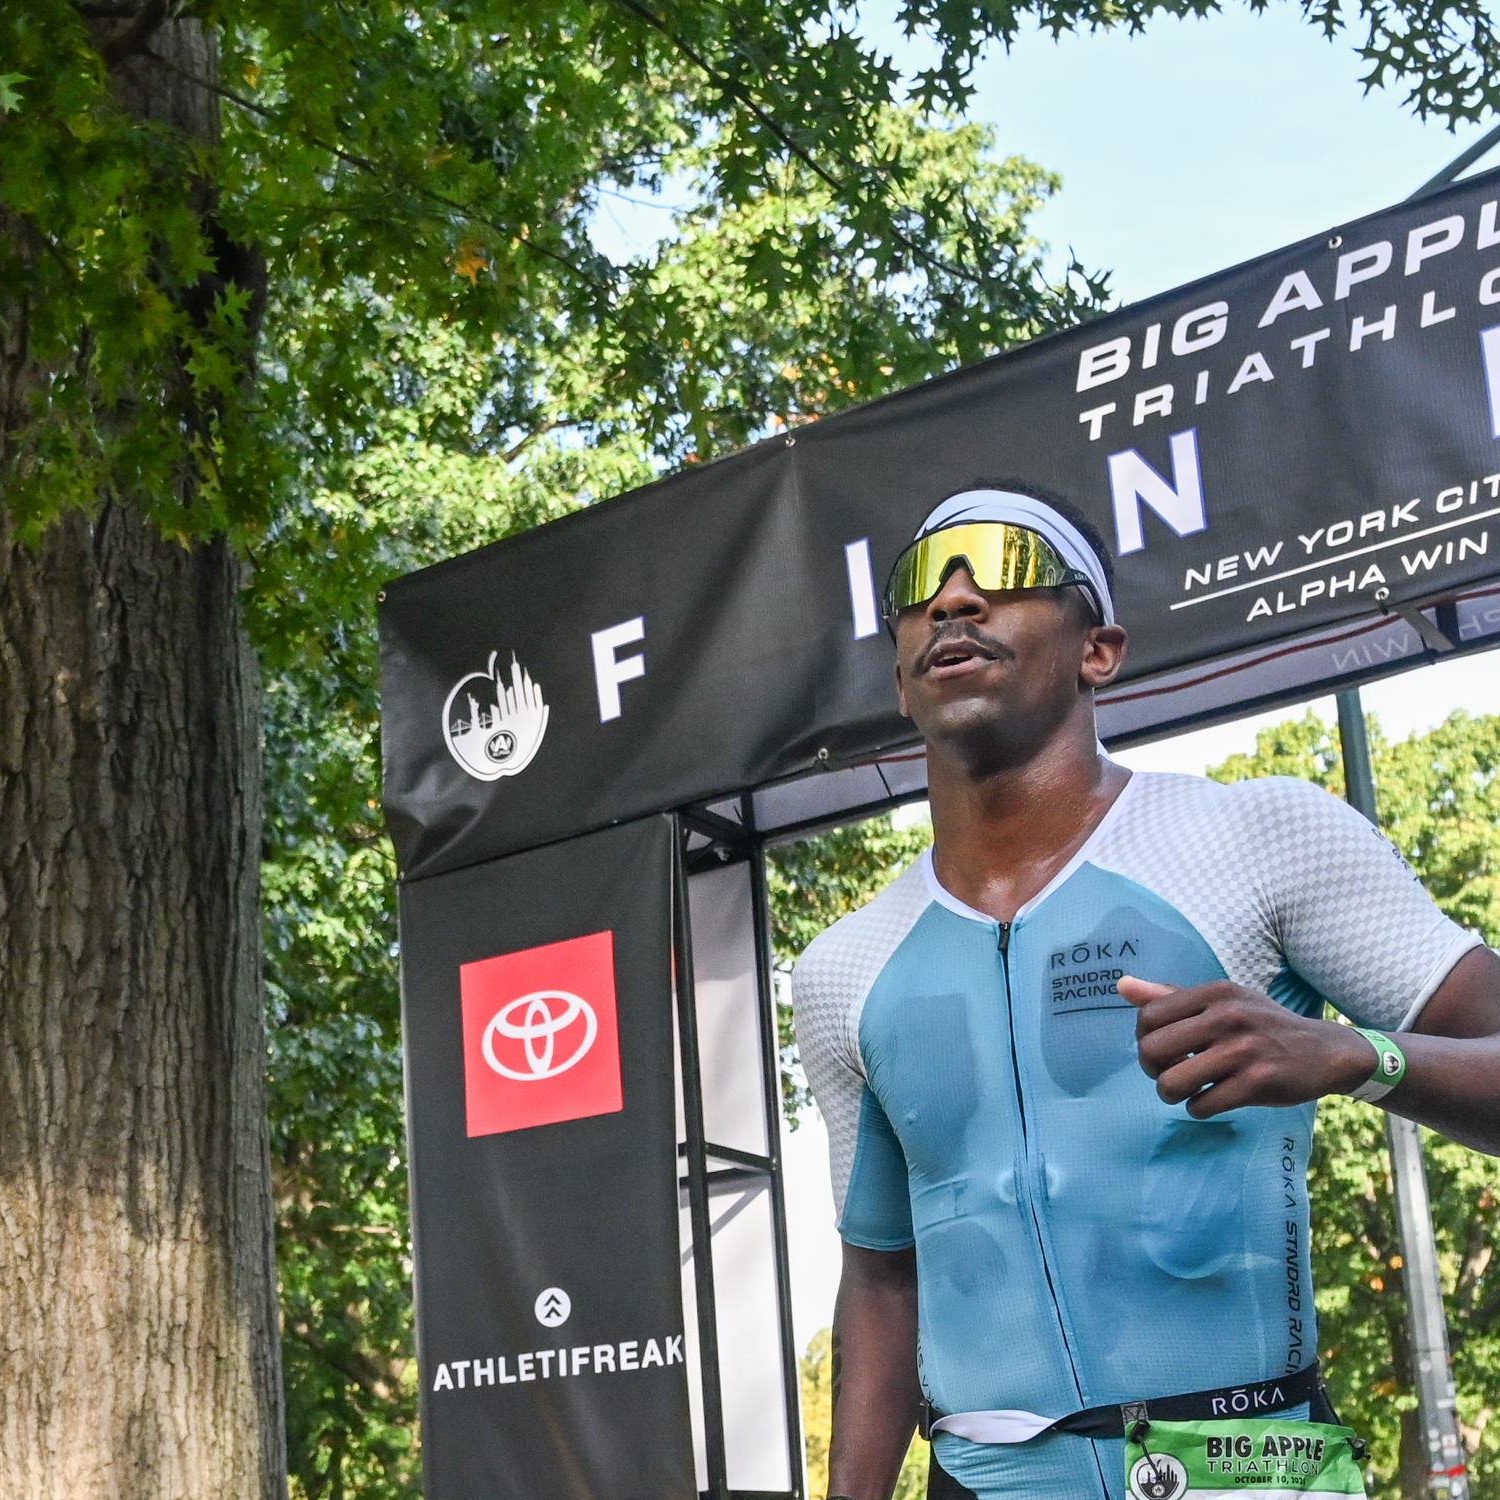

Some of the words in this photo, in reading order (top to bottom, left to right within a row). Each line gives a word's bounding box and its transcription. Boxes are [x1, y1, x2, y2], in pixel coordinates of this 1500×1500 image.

[1076, 300, 1229, 393] BIG
[1184, 541, 1284, 591] NEW
[1297, 498, 1422, 555] YORK
[1246, 563, 1387, 622] ALPHA
[1401, 532, 1489, 576] WIN
[1052, 968, 1123, 989] STNDRD
[1053, 983, 1119, 1002] RACING
[1286, 1220, 1301, 1312] STNDRD
[433, 1333, 686, 1392] ATHLETIFREAK
[1206, 1435, 1253, 1459] BIG
[1261, 1434, 1324, 1461] APPLE
[1206, 1459, 1318, 1476] TRIATHLON
[1234, 1475, 1273, 1484] OCTOBER
